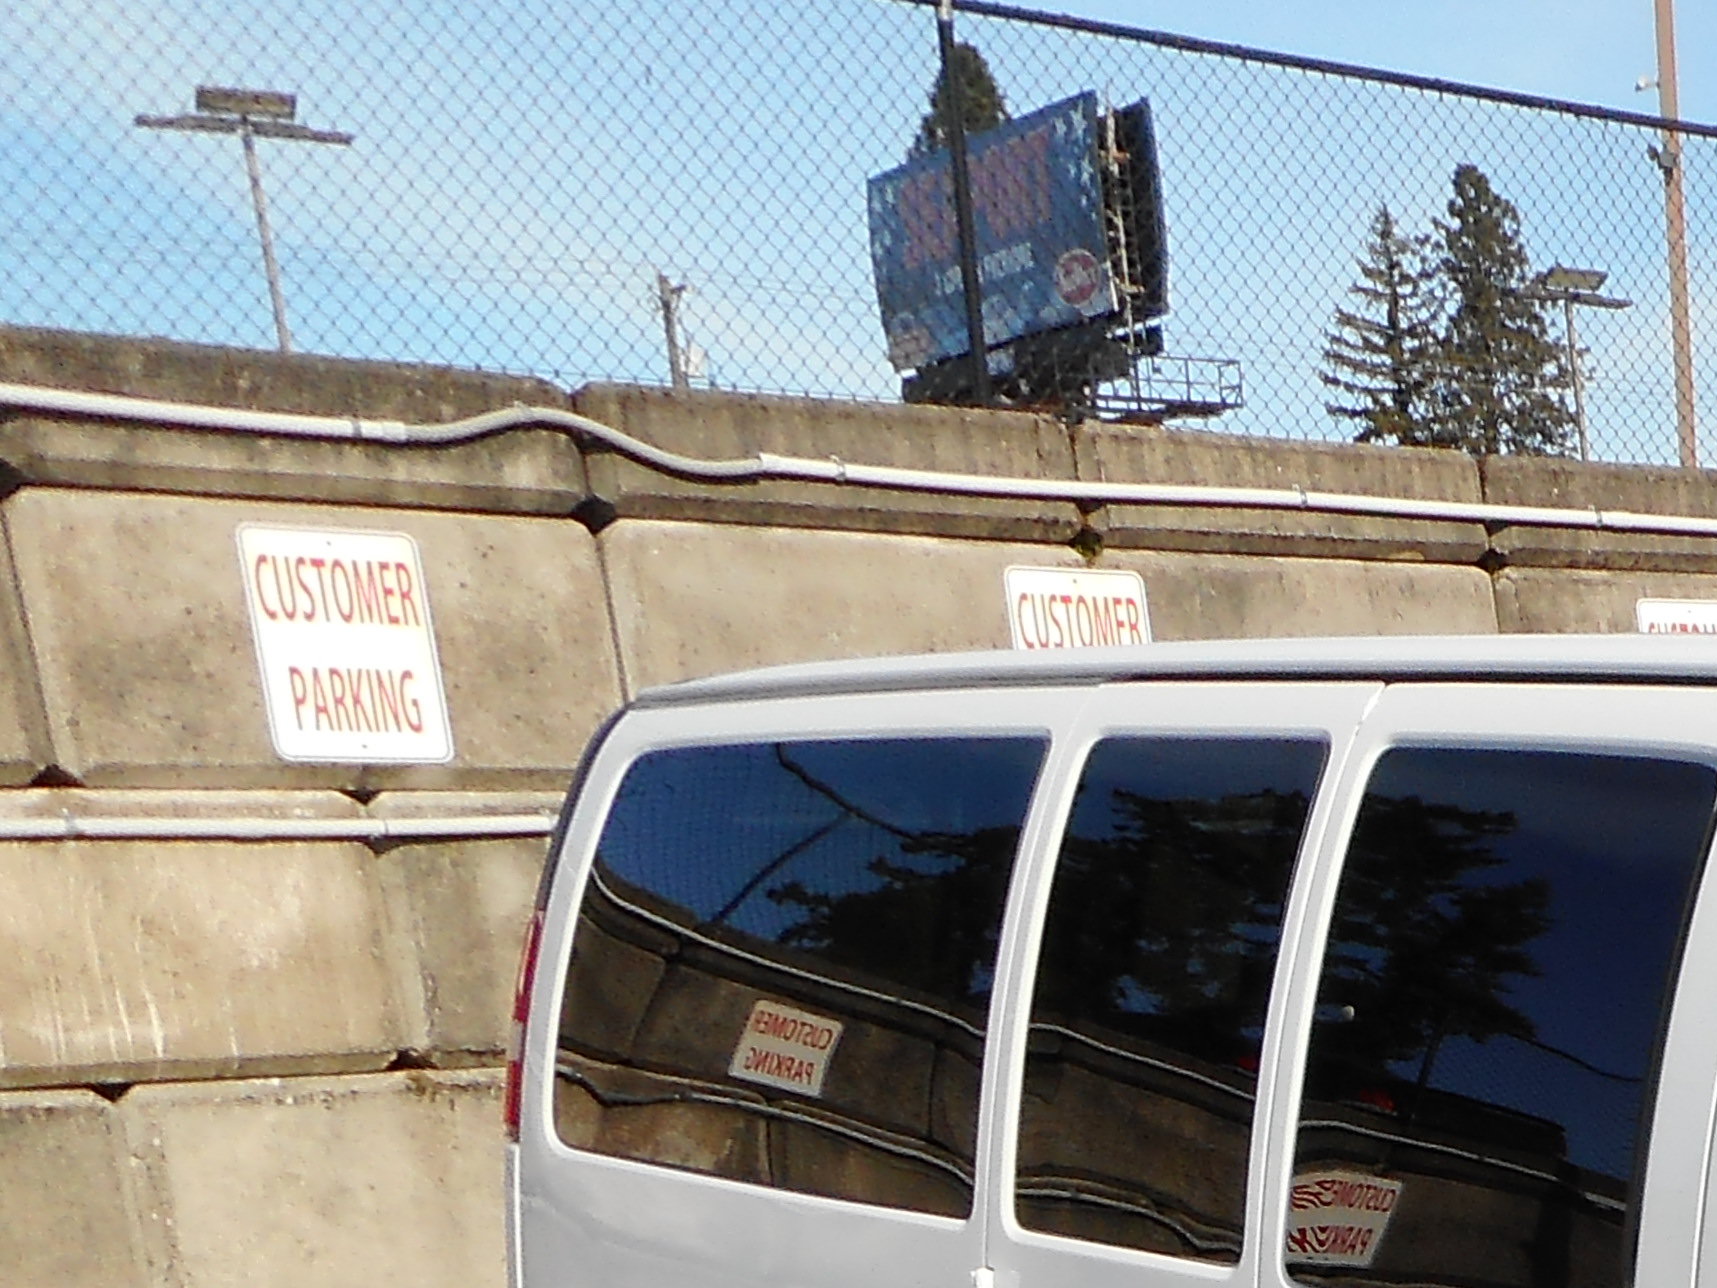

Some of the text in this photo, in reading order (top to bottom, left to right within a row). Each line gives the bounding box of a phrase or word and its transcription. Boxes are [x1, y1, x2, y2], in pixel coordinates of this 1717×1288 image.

[254, 553, 421, 627] CUSTOMER
[1017, 591, 1144, 649] CUSTOMER
[287, 665, 424, 734] PARKING
